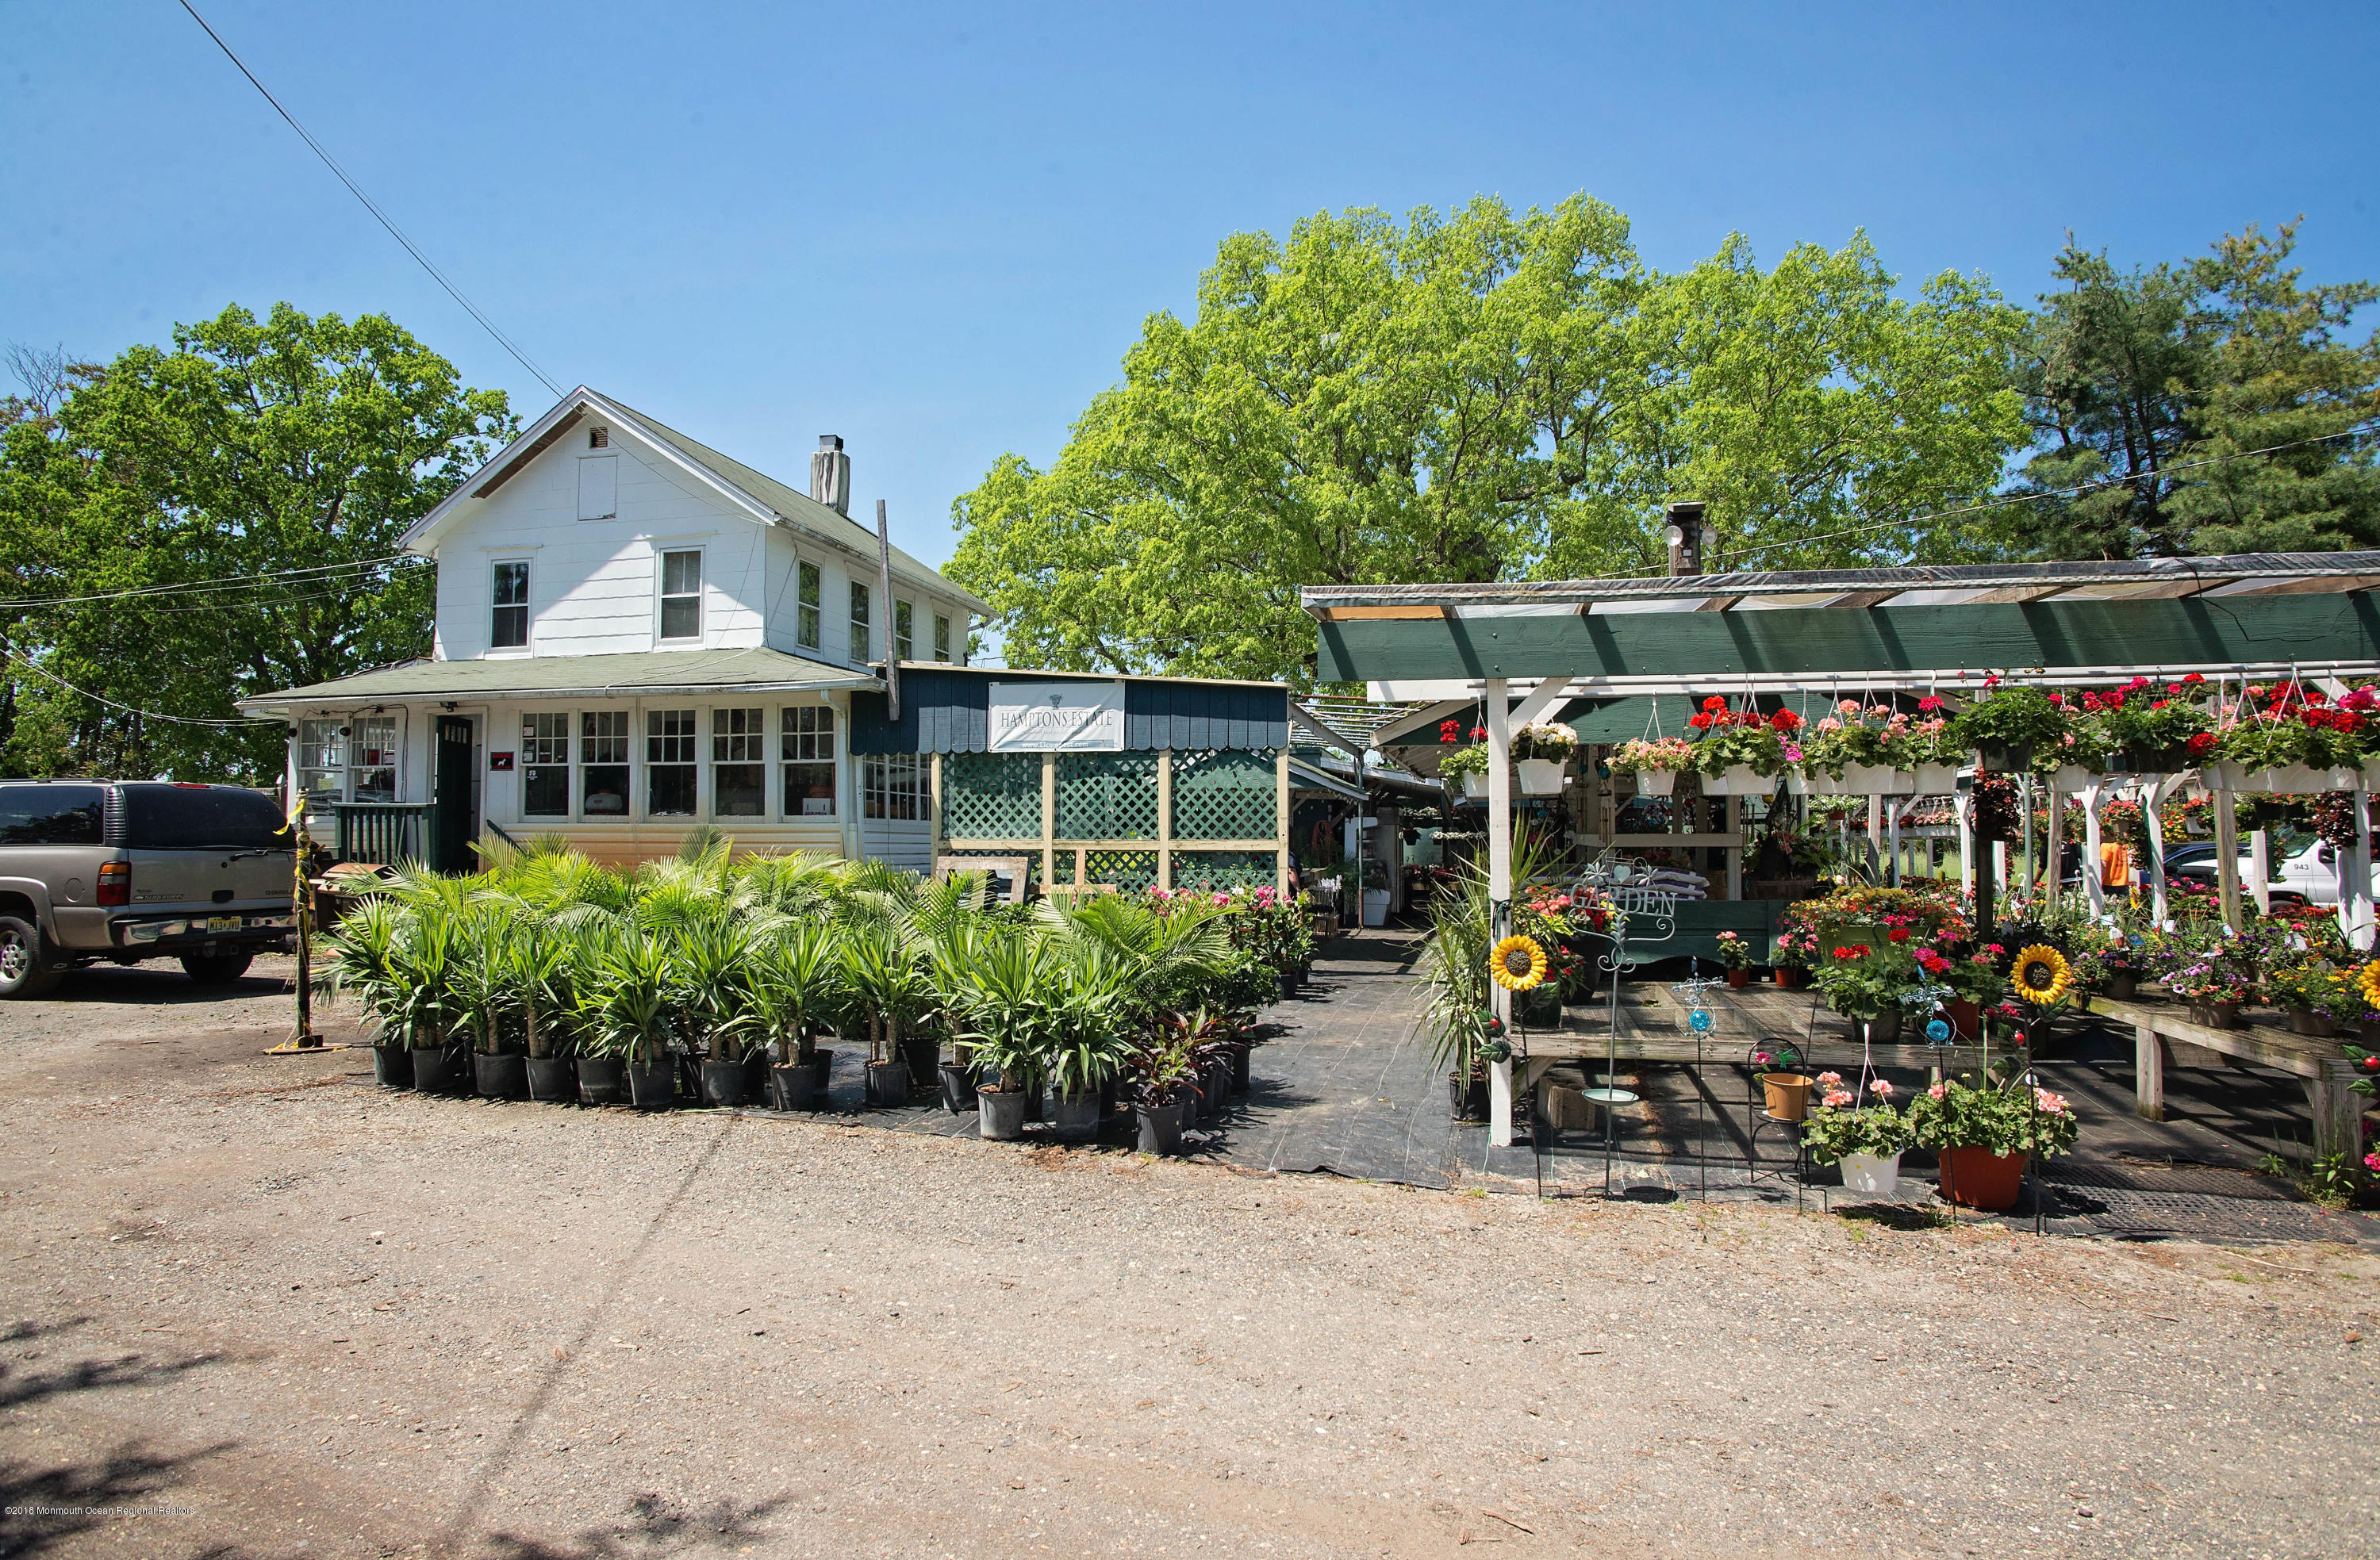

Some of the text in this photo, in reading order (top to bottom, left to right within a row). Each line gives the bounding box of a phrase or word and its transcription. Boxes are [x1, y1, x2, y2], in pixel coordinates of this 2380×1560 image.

[1001, 711, 1112, 726] HAMPTONS ESTATE
[1570, 883, 1678, 918] GARDEN
